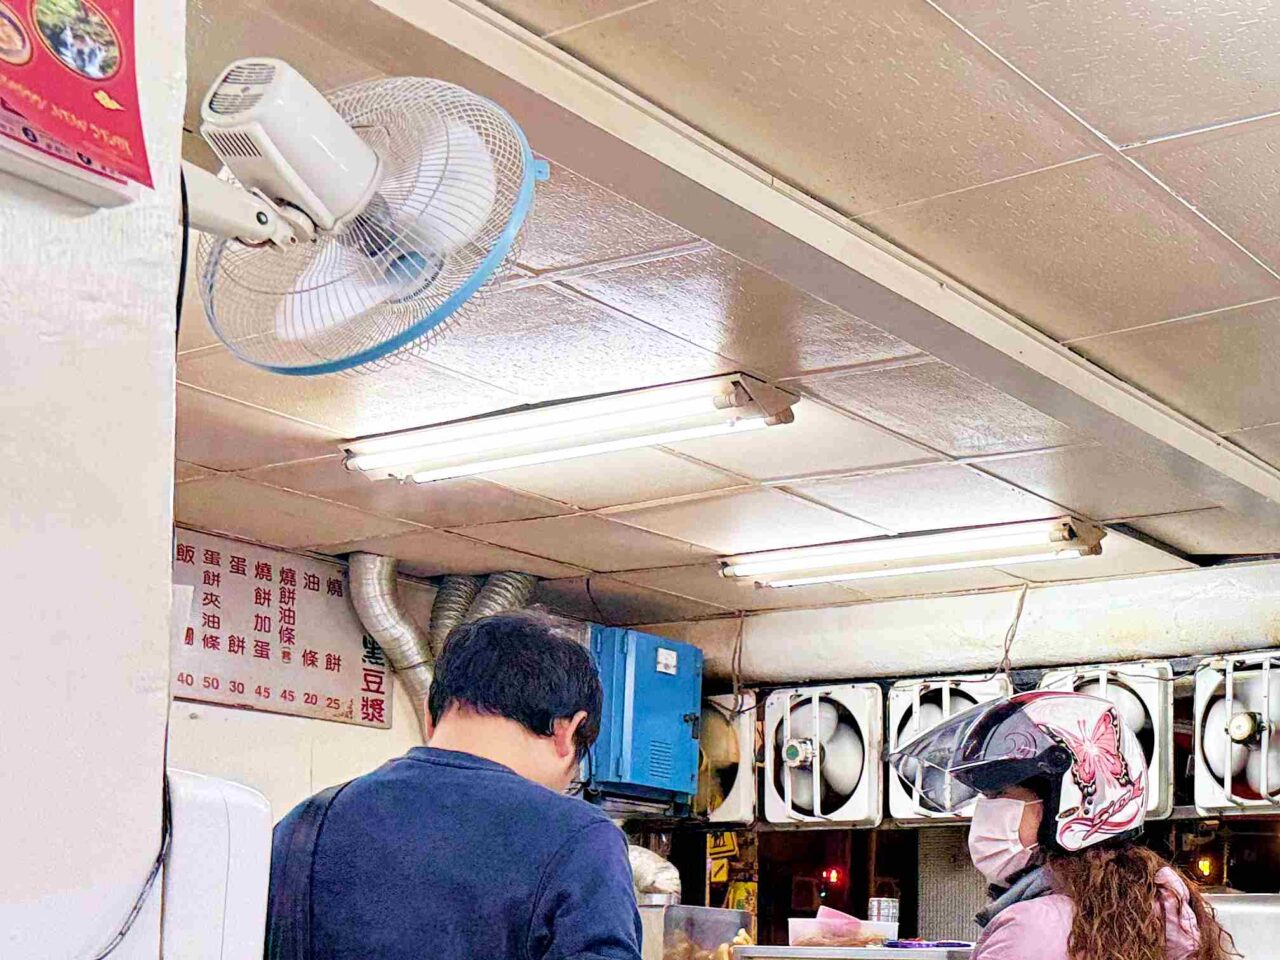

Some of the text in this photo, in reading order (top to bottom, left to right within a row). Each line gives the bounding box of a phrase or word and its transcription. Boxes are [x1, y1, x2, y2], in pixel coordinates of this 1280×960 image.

[202, 549, 221, 651] 蛋餅夾油條
[228, 555, 247, 655] 蛋餅
[253, 561, 272, 660] 燒餅加蛋
[302, 572, 320, 668] 油條
[325, 577, 344, 673] 燒餅
[177, 672, 194, 687] 40
[202, 676, 220, 690] 50
[229, 680, 245, 694] 30
[254, 685, 271, 699] 45
[280, 689, 295, 702] 45
[303, 692, 318, 706] 20
[326, 697, 341, 710] 25
